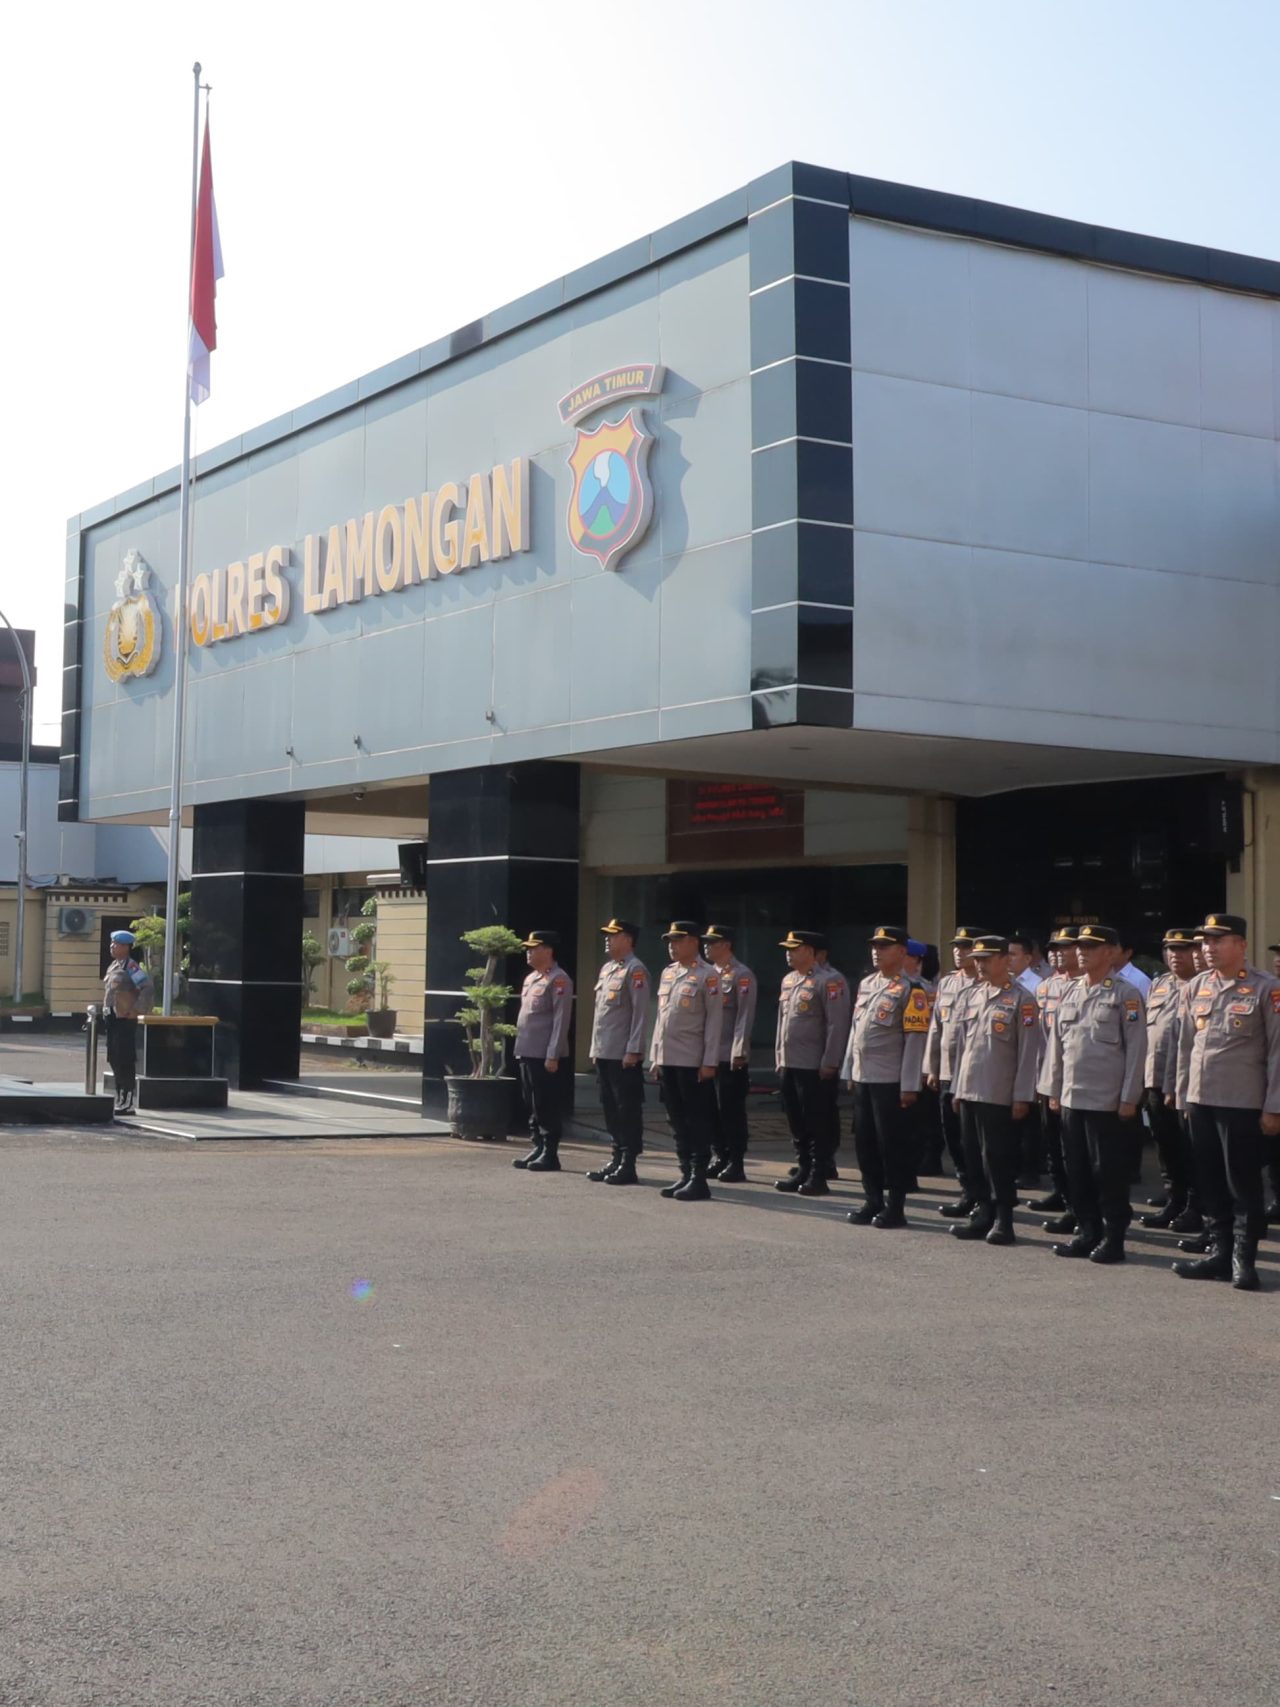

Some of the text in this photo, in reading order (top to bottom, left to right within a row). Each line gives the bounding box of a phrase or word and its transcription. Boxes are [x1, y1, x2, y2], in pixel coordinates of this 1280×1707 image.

[568, 370, 644, 412] JAWA TIMUR
[303, 456, 530, 614] LAMONGAN
